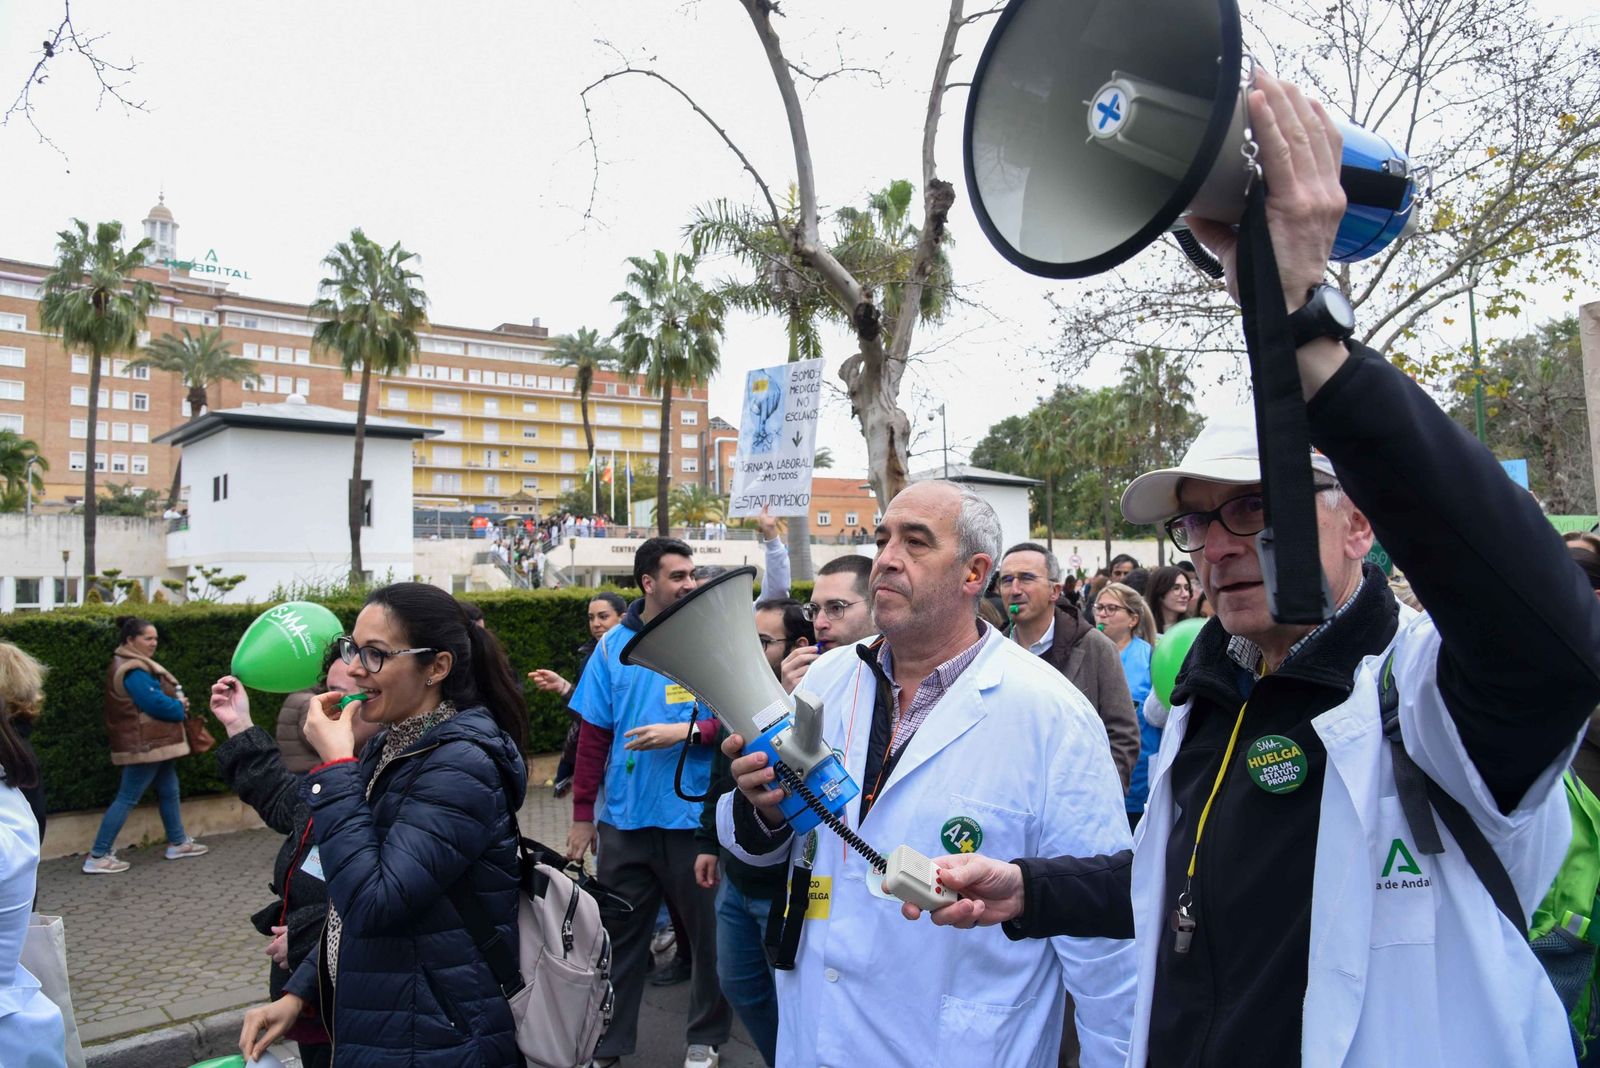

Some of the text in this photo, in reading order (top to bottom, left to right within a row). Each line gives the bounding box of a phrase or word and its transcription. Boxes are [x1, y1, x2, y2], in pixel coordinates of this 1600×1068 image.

[797, 397, 809, 408] NO
[741, 458, 811, 473] JORNADA LABORAL
[757, 471, 798, 482] OMO TODOS
[611, 545, 636, 553] CENTRO
[1248, 746, 1301, 768] HUELGA
[1259, 766, 1300, 782] ESTATUTO
[1262, 761, 1292, 774] POR UN
[1267, 774, 1297, 787] PROPIO
[1384, 880, 1398, 889] de
[1401, 876, 1433, 889] Andal
